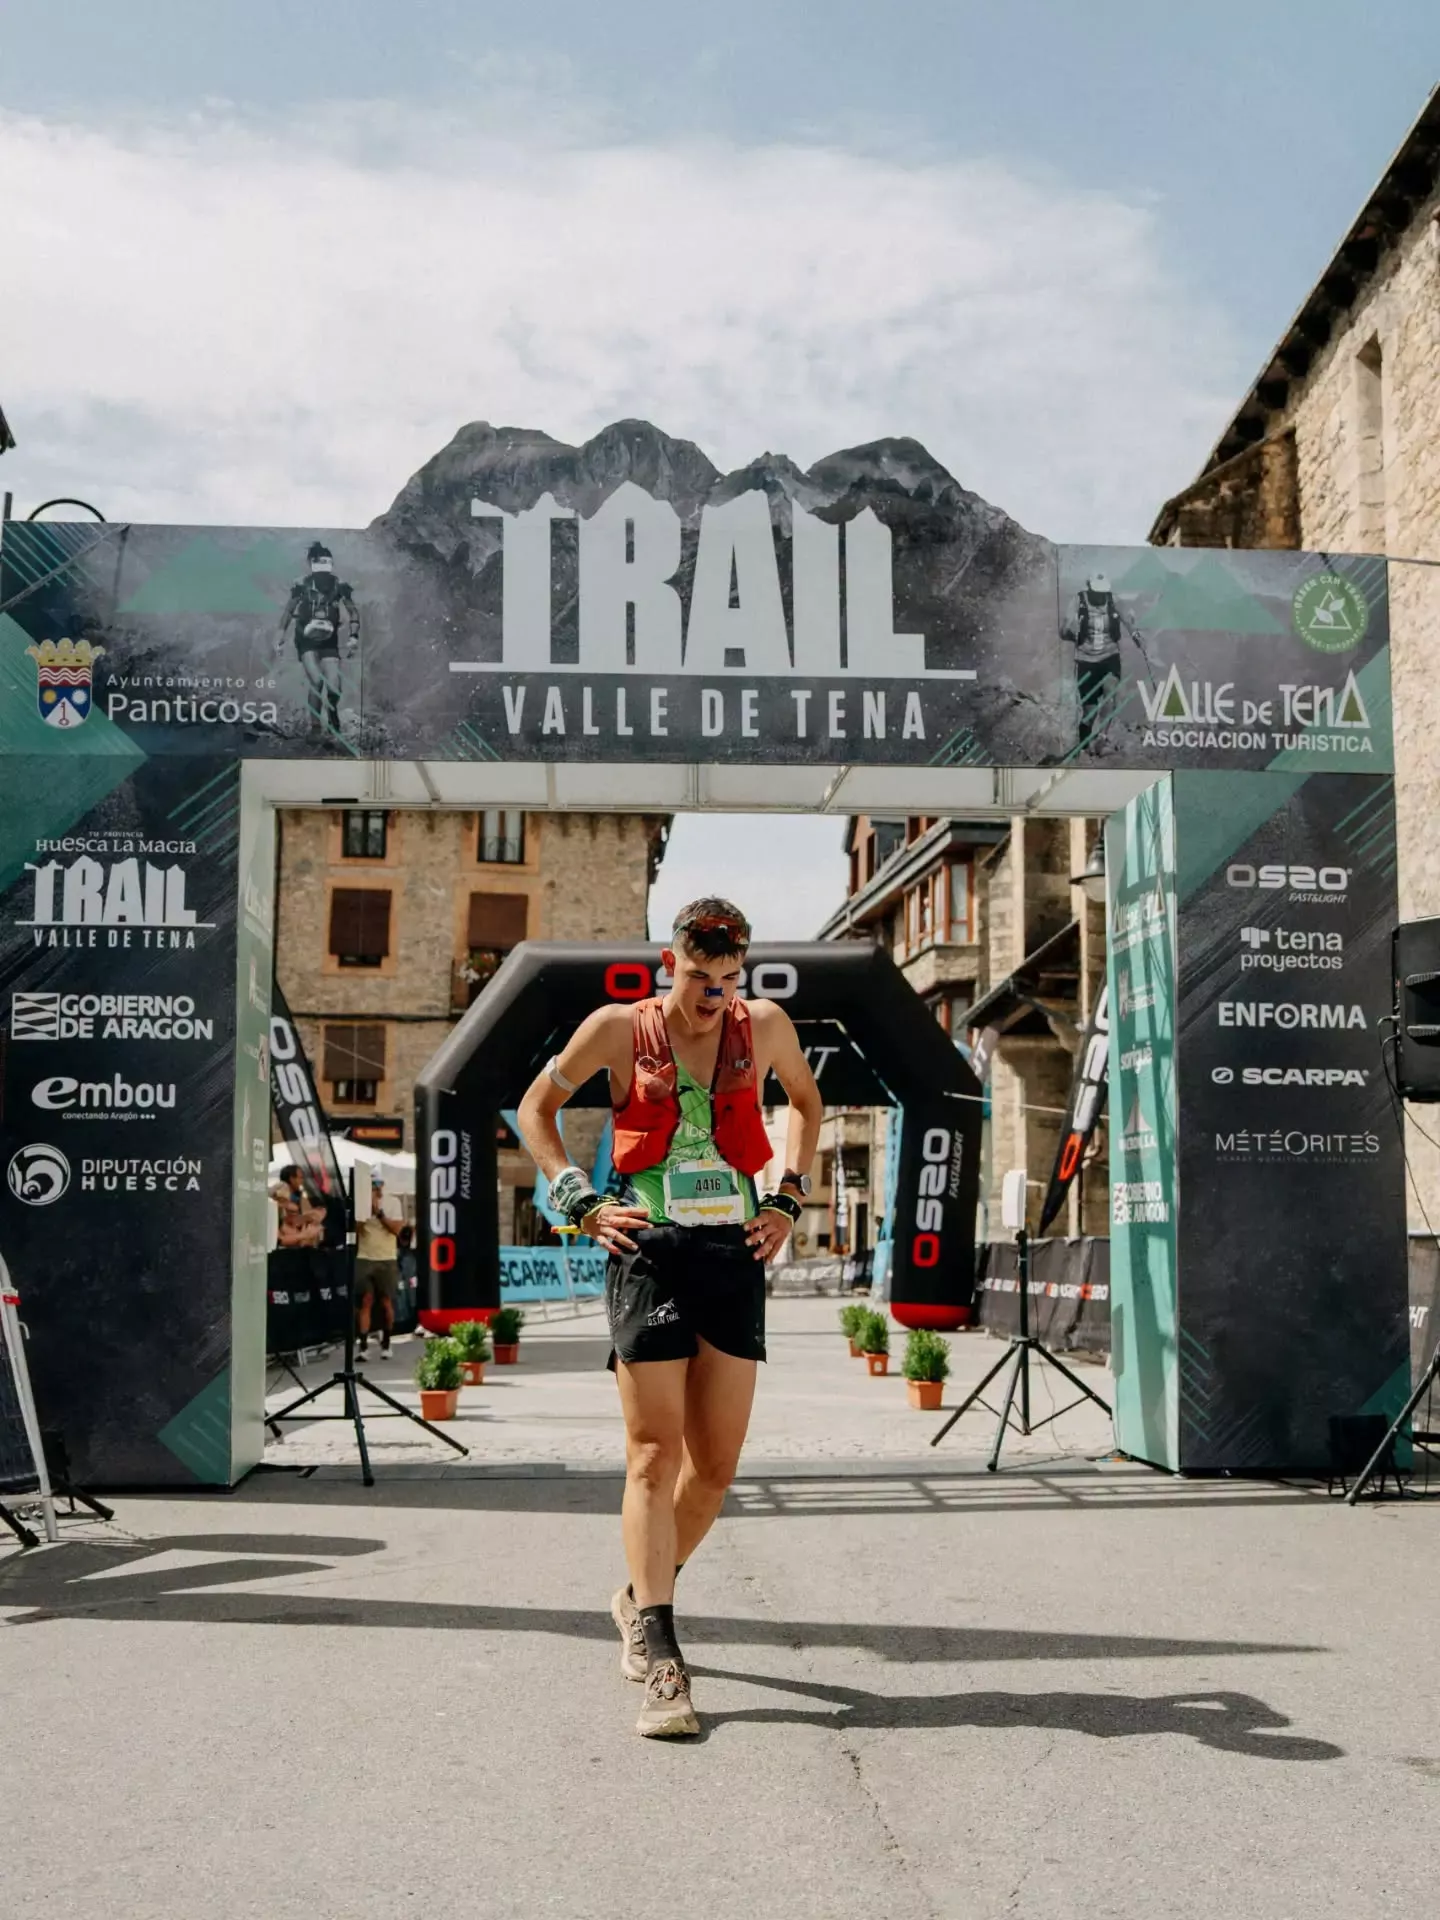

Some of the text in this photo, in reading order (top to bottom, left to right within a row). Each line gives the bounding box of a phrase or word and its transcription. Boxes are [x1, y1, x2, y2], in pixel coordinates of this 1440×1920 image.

[471, 480, 926, 677] TRAIL
[106, 673, 277, 689] Ayuntamiento de
[107, 692, 278, 724] Panticosa
[502, 685, 927, 740] VALLE DE TENA
[1142, 729, 1374, 753] ASOCIACION TURISTICA
[24, 855, 197, 926] TRAIL
[33, 929, 196, 949] VALLE DE TENA
[1274, 927, 1343, 951] tena
[1241, 953, 1343, 972] proyectos
[60, 994, 195, 1017] GOBIERNO
[1218, 1002, 1367, 1029] ENFORMA
[60, 1018, 213, 1040] DE ARAGON
[1242, 1068, 1366, 1086] SCARPA
[31, 1072, 176, 1110] embou
[62, 1111, 138, 1122] conectando Aragón
[82, 1156, 201, 1174] DIPUTACIÓN
[81, 1177, 201, 1191] HUESCA
[695, 1178, 721, 1192] 4416
[499, 1260, 562, 1287] SCARPA
